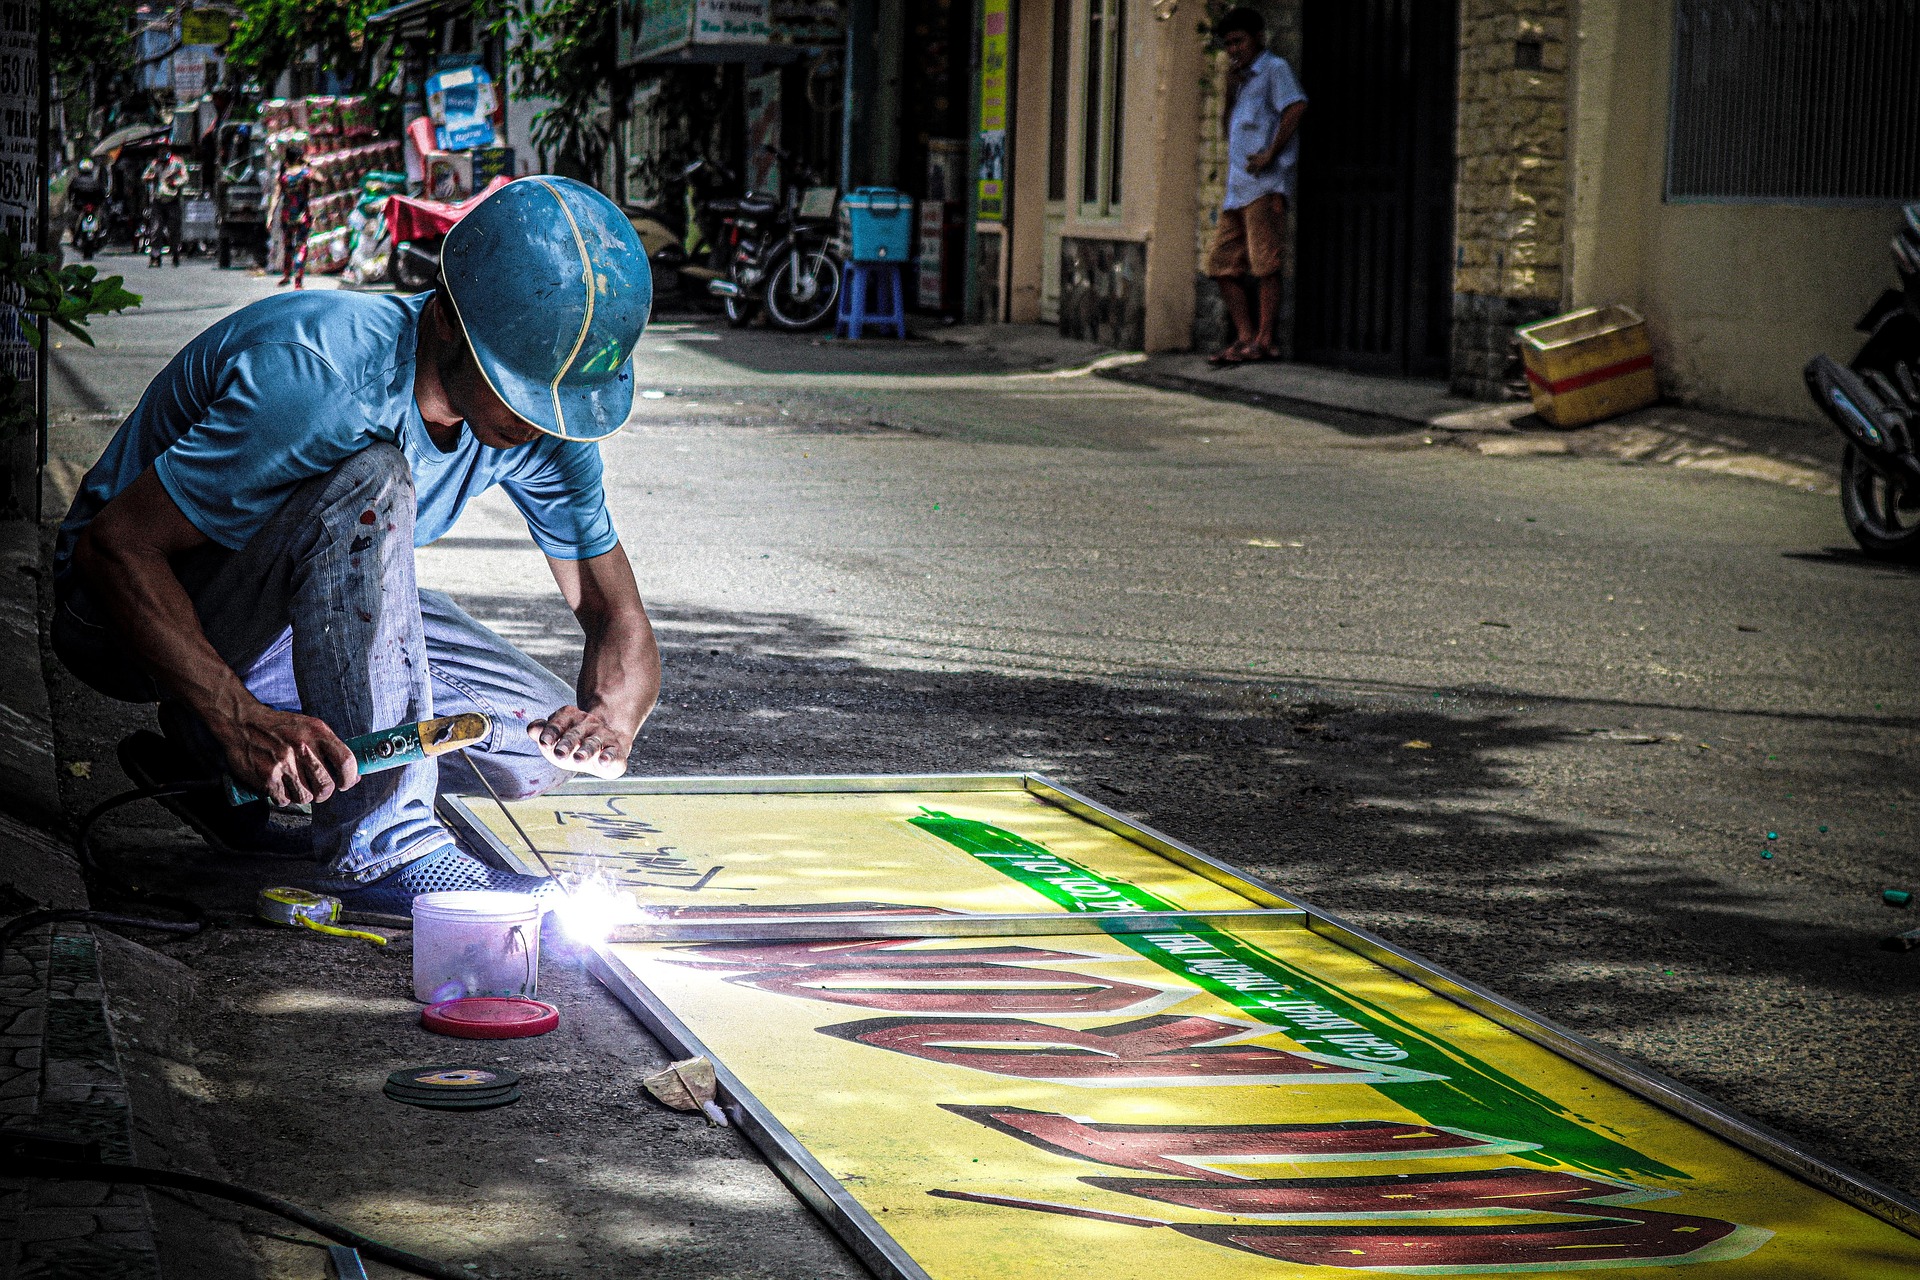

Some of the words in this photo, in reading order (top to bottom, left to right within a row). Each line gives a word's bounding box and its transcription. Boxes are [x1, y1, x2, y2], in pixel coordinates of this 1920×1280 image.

[1043, 877, 1121, 898] CON
[1185, 958, 1287, 991] NHÂM
[1240, 1000, 1363, 1030] KHÁT
